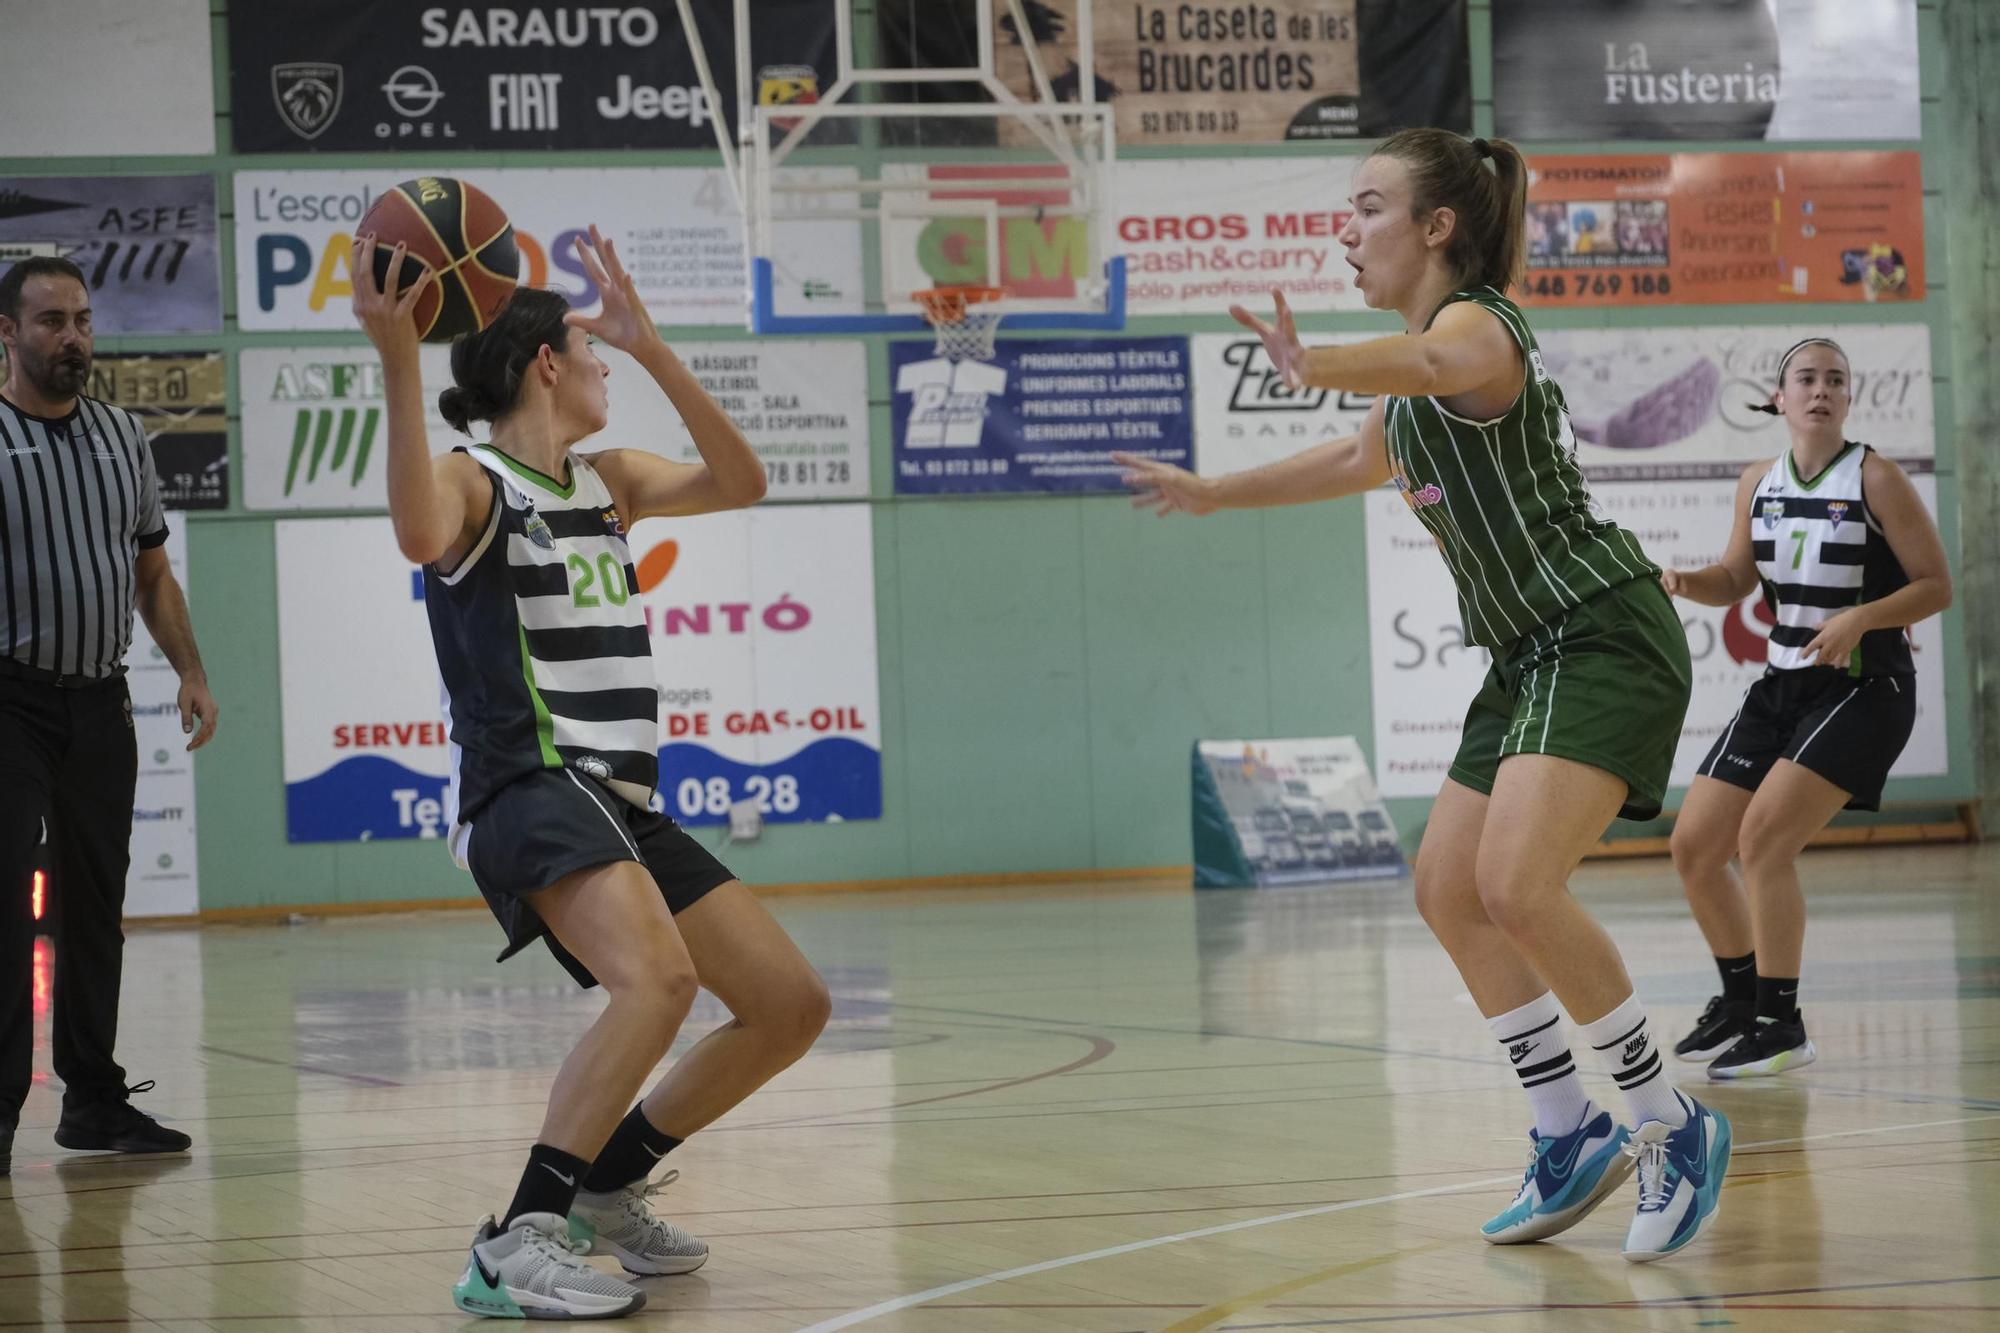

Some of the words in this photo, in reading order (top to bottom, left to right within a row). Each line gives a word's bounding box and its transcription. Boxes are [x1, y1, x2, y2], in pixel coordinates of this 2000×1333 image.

[421, 8, 658, 47] SARAUTO
[1136, 3, 1166, 42] La
[1179, 4, 1277, 42] Caseta
[1288, 12, 1312, 40] de
[1318, 12, 1349, 41] les
[1138, 46, 1315, 93] Brucardes
[1605, 42, 1649, 72] La
[597, 75, 722, 127] Jeep
[1605, 64, 1781, 104] Fusteria
[489, 74, 562, 131] FIAT
[374, 122, 457, 138] OPEL
[98, 205, 198, 233] ASFE
[254, 187, 369, 221] L'escol
[1118, 214, 1249, 242] GROS
[1264, 212, 1353, 239] MER
[1125, 247, 1327, 274] cash&carry
[272, 362, 383, 400] ASFE
[1227, 422, 1361, 437] SABAT
[767, 462, 789, 483] 78
[1790, 530, 1809, 571] 7
[566, 551, 629, 608] 20
[644, 594, 811, 636] INTÓ
[668, 712, 709, 738] DE
[725, 707, 865, 735] GAS-OIL
[677, 776, 731, 817] 08
[744, 775, 800, 814] 28
[1509, 1041, 1531, 1056] NIKE
[1624, 1032, 1646, 1056] NIKE
